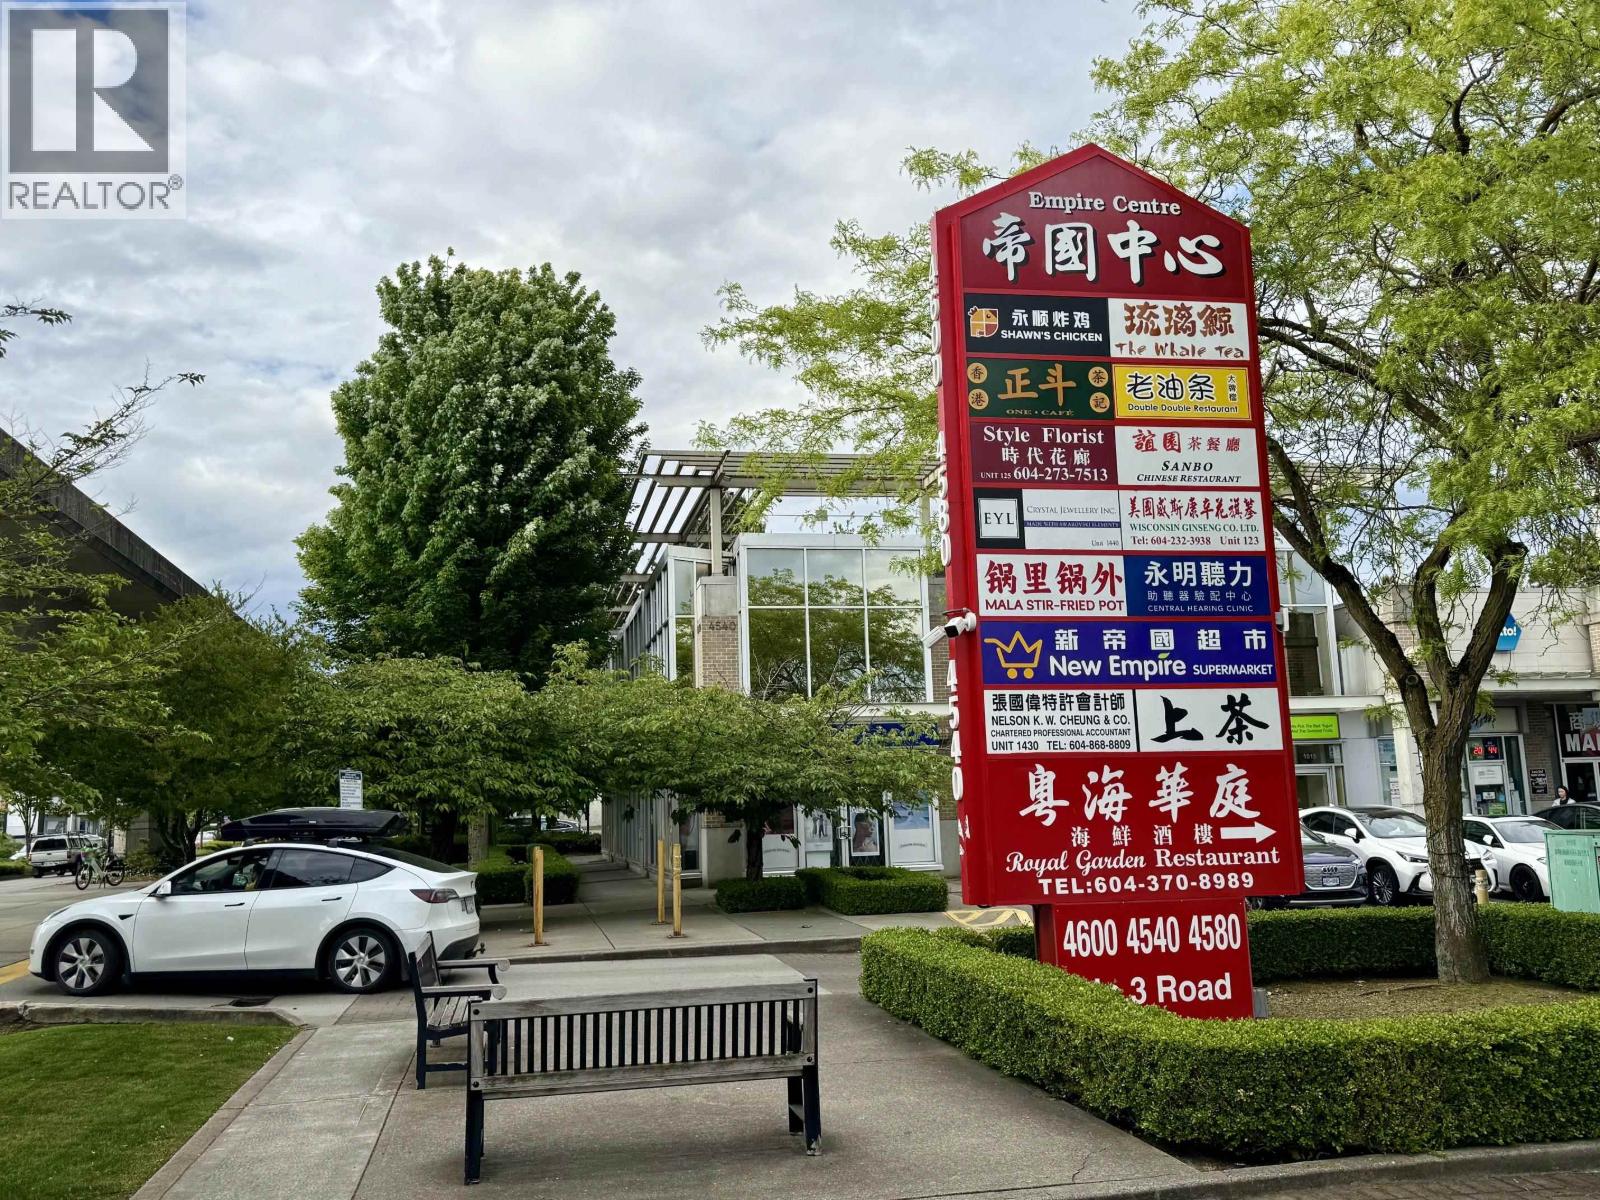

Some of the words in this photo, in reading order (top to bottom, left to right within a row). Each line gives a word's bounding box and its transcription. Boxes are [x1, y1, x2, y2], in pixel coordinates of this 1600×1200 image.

[1028, 192, 1105, 214] Empire
[1112, 195, 1181, 215] Centre
[982, 212, 1223, 284] 帝國中心
[1011, 309, 1090, 329] 永顺炸鸡
[1000, 330, 1051, 340] SHAWN'S
[1053, 331, 1103, 342] CHICKEN
[1114, 341, 1146, 356] The
[1154, 342, 1207, 357] Whale
[1214, 346, 1244, 358] Tea
[997, 363, 1077, 407] 正斗
[1127, 373, 1215, 401] 老油条
[1128, 403, 1159, 411] Double
[1161, 404, 1191, 412] Double
[1193, 405, 1238, 413] Restaurant
[983, 425, 1030, 446] Style
[1041, 427, 1105, 444] Florist
[1001, 446, 1090, 466] 時代花廊
[1161, 460, 1213, 472] SANBO
[1013, 467, 1108, 481] 604-273-7513
[1136, 473, 1178, 482] CHINESE
[1180, 474, 1242, 483] RESTAURANT
[984, 512, 1014, 525] EYL
[1026, 506, 1058, 514] CRYSTAL
[1060, 506, 1098, 515] JEWELLERY
[1100, 507, 1116, 515] INC.
[1130, 523, 1180, 532] WISCONSIN
[1181, 524, 1221, 532] GINSENG
[1223, 524, 1239, 532] CO.
[1240, 524, 1259, 532] LTD.
[1130, 535, 1148, 545] Tel:
[1150, 536, 1211, 545] 604-232-3938
[1220, 536, 1240, 545] Unit
[1243, 536, 1259, 545] 123
[984, 560, 1123, 597] 锅里锅外
[1144, 561, 1252, 587] 永明聽力
[985, 599, 1024, 610] MALA
[1026, 600, 1095, 611] STIR-FRIED
[1098, 600, 1124, 611] POT
[1055, 629, 1267, 651] 新帝國超市
[1049, 655, 1102, 676] New
[1109, 653, 1186, 681] Empire
[1193, 664, 1273, 675] SUPERMARKET
[992, 692, 1125, 712] 張國偉特許會計師
[991, 715, 1030, 726] NELSON
[1033, 715, 1043, 726] K.
[1045, 715, 1056, 726] W.
[1060, 715, 1100, 725] CHEUNG
[1103, 715, 1111, 725] &
[1113, 714, 1130, 725] CO.
[1150, 692, 1270, 744] 上茶
[991, 729, 1032, 737] CHARTERED
[1033, 728, 1084, 737] PROFESSIONAL
[1086, 728, 1131, 736] ACCOUNTANT
[991, 741, 1014, 750] UNIT
[1016, 741, 1039, 751] 1430
[1046, 740, 1066, 750] TEL:
[1069, 740, 1131, 750] 604-868-8809
[1071, 823, 1213, 848] 海鮮酒樓
[1006, 850, 1069, 878] Royal
[1075, 849, 1146, 876] Garden
[1154, 846, 1280, 868] Restaurant
[1063, 918, 1118, 958] 4600
[1126, 916, 1180, 954] 4540
[1188, 913, 1242, 951] 4580
[1130, 976, 1147, 1005] 3
[1156, 972, 1232, 1003] Road
